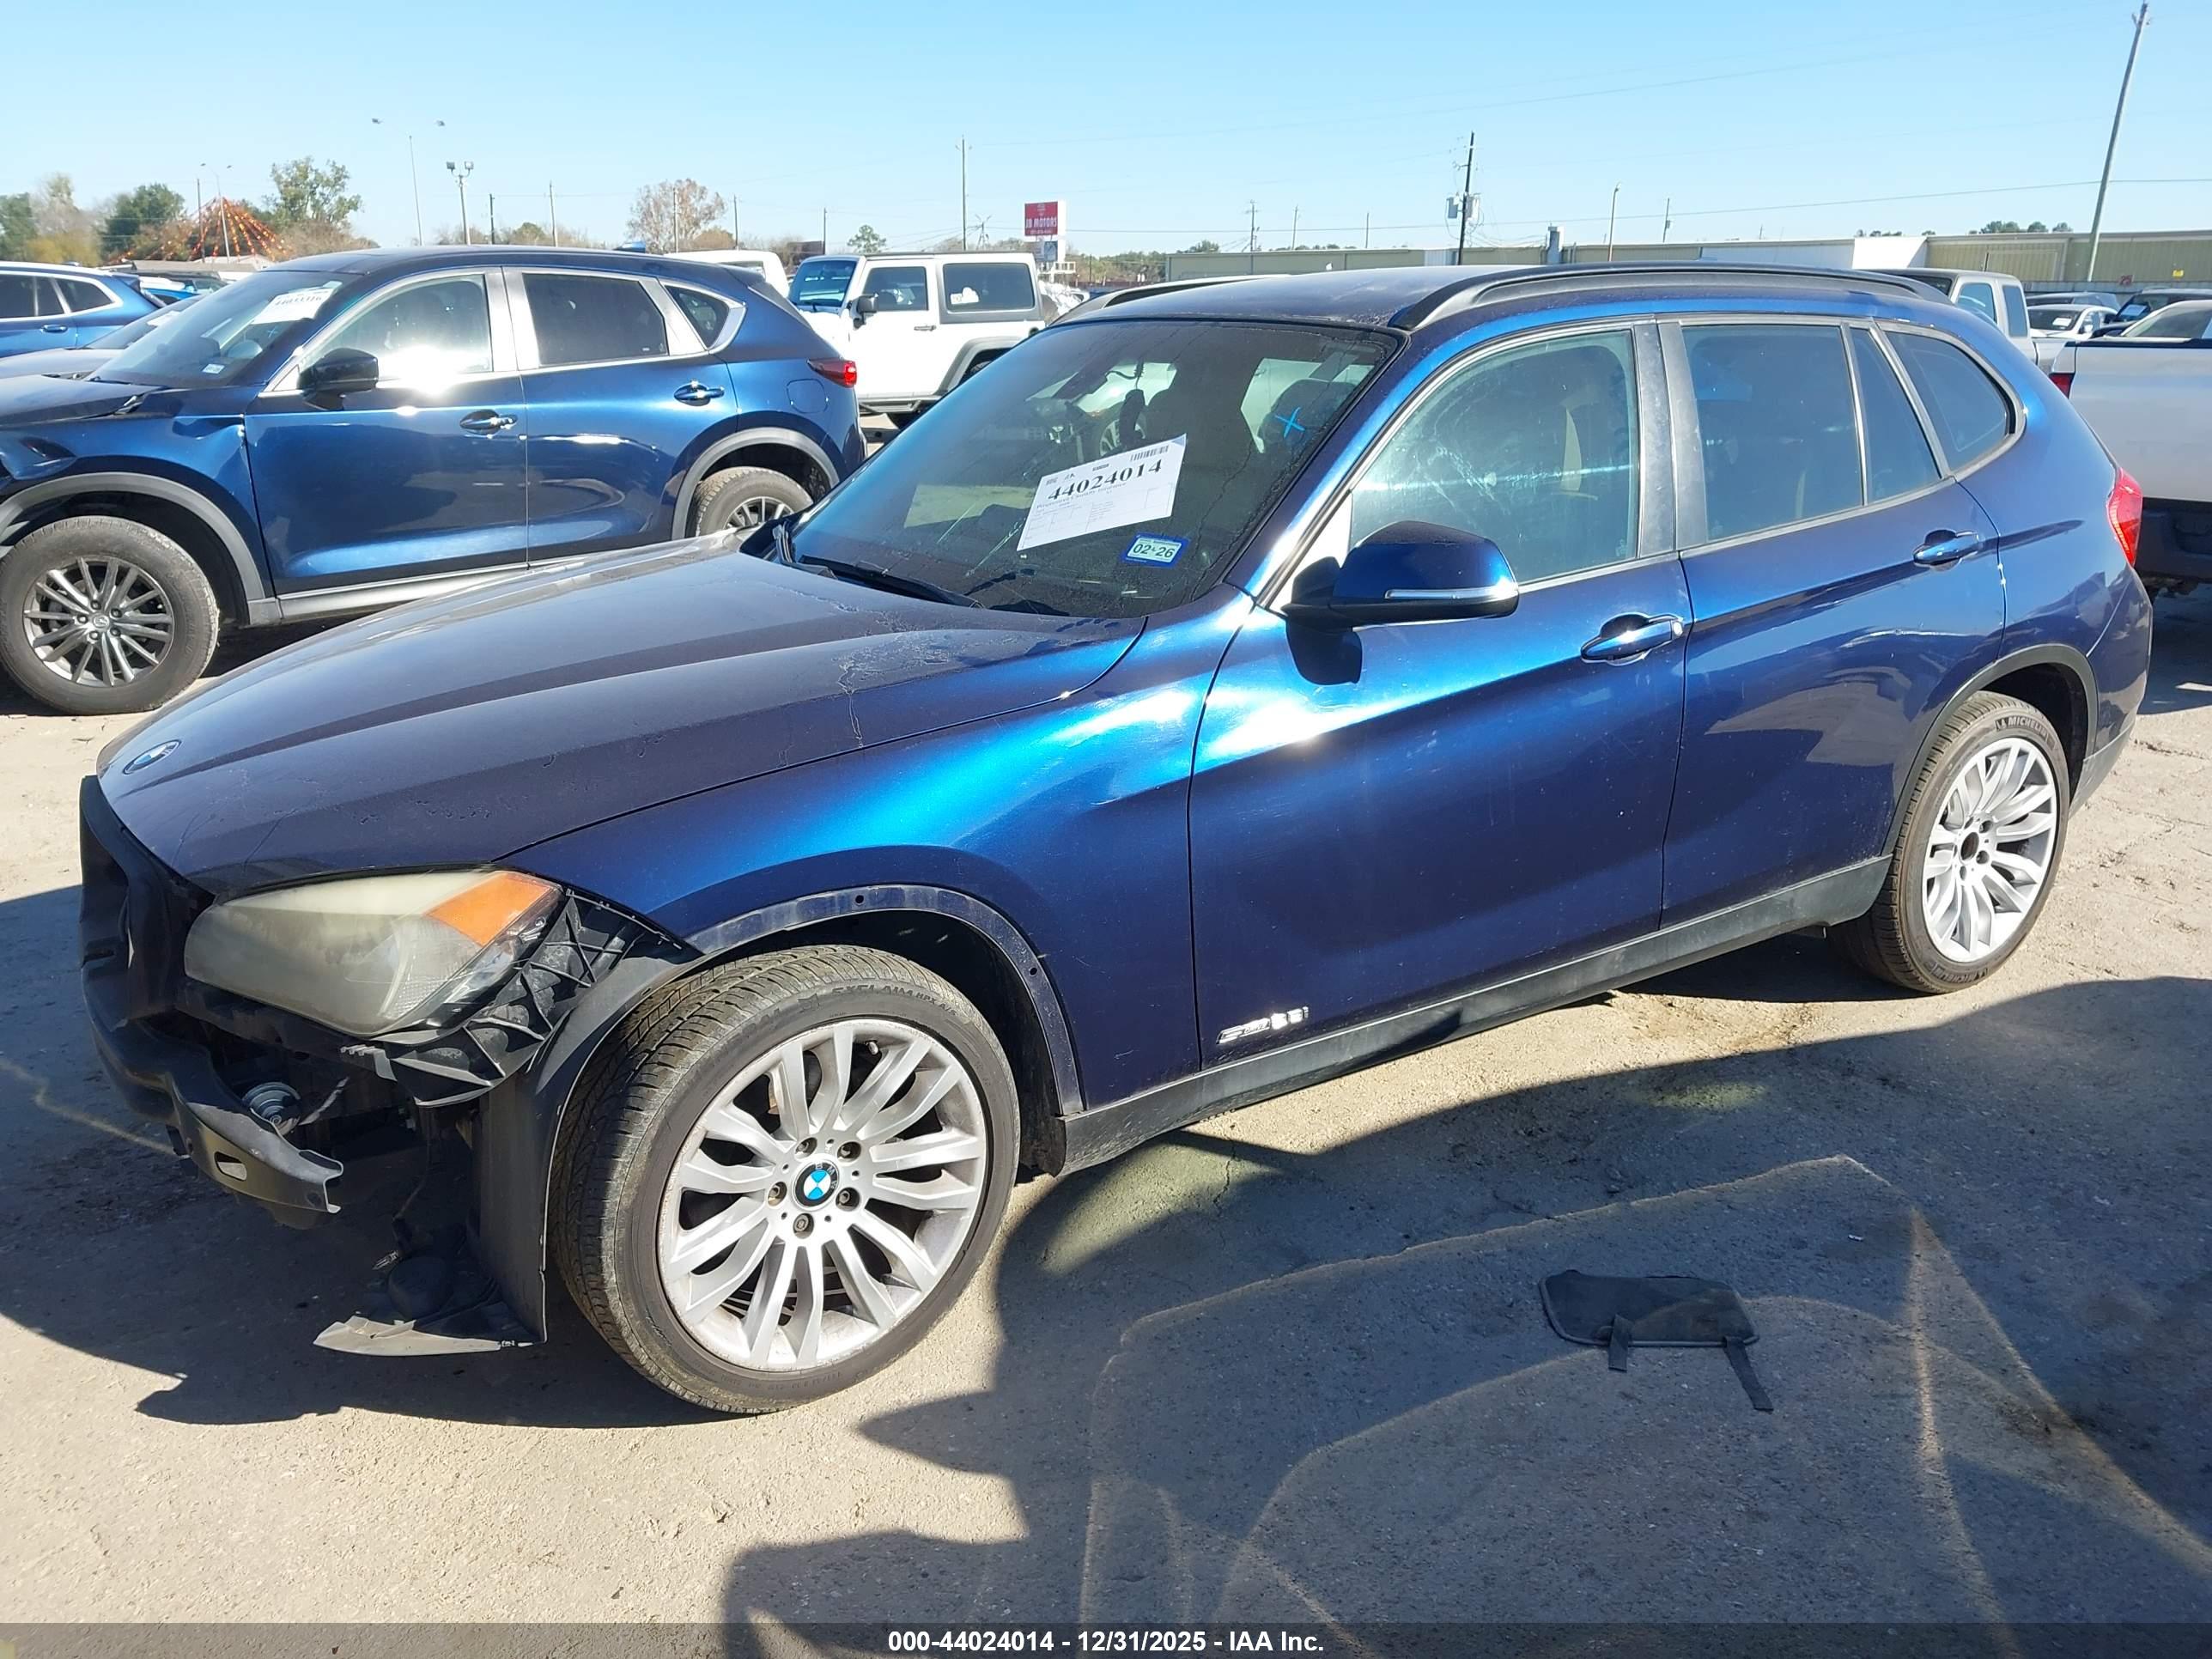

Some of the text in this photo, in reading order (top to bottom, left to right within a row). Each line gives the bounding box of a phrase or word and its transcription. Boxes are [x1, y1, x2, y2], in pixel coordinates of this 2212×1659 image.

[1048, 459, 1163, 500] 44024014
[1133, 544, 1176, 557] 02 26
[2008, 716, 2048, 737] MICHELIN
